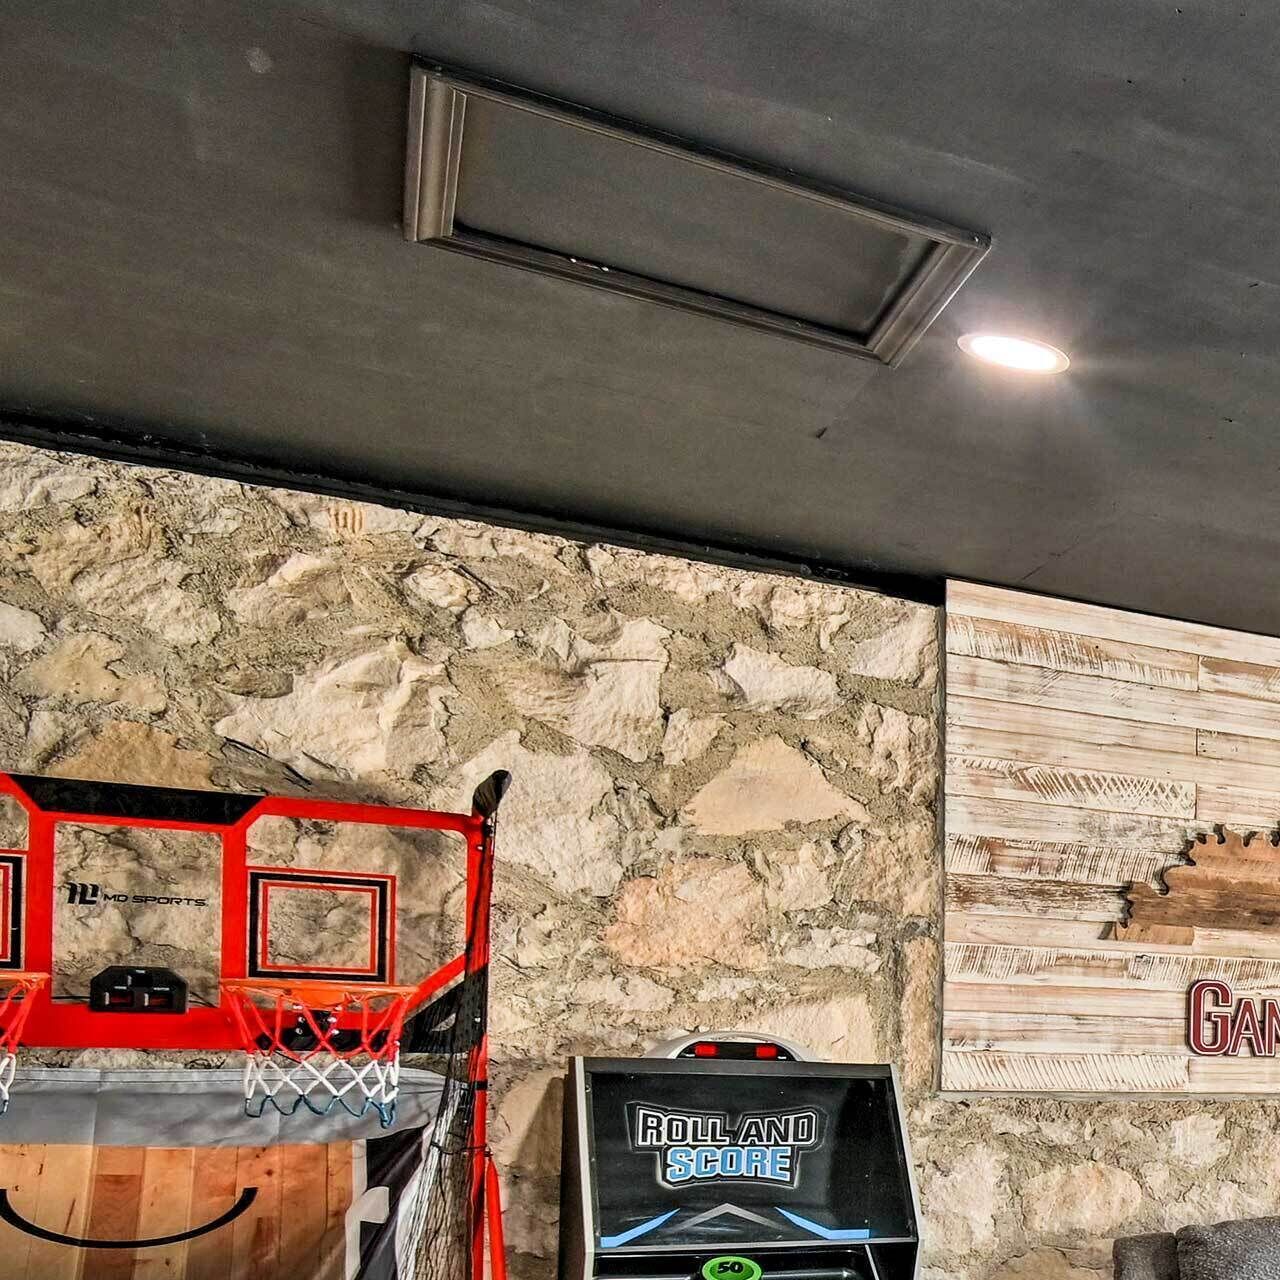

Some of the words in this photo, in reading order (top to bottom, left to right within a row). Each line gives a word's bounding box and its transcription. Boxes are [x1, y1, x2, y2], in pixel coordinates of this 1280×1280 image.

[103, 893, 128, 903] MD
[132, 894, 209, 906] SPORTS
[637, 1108, 732, 1146] ROLL
[736, 1111, 819, 1146] AND
[665, 1146, 792, 1183] SCORE
[717, 1261, 744, 1274] 50
